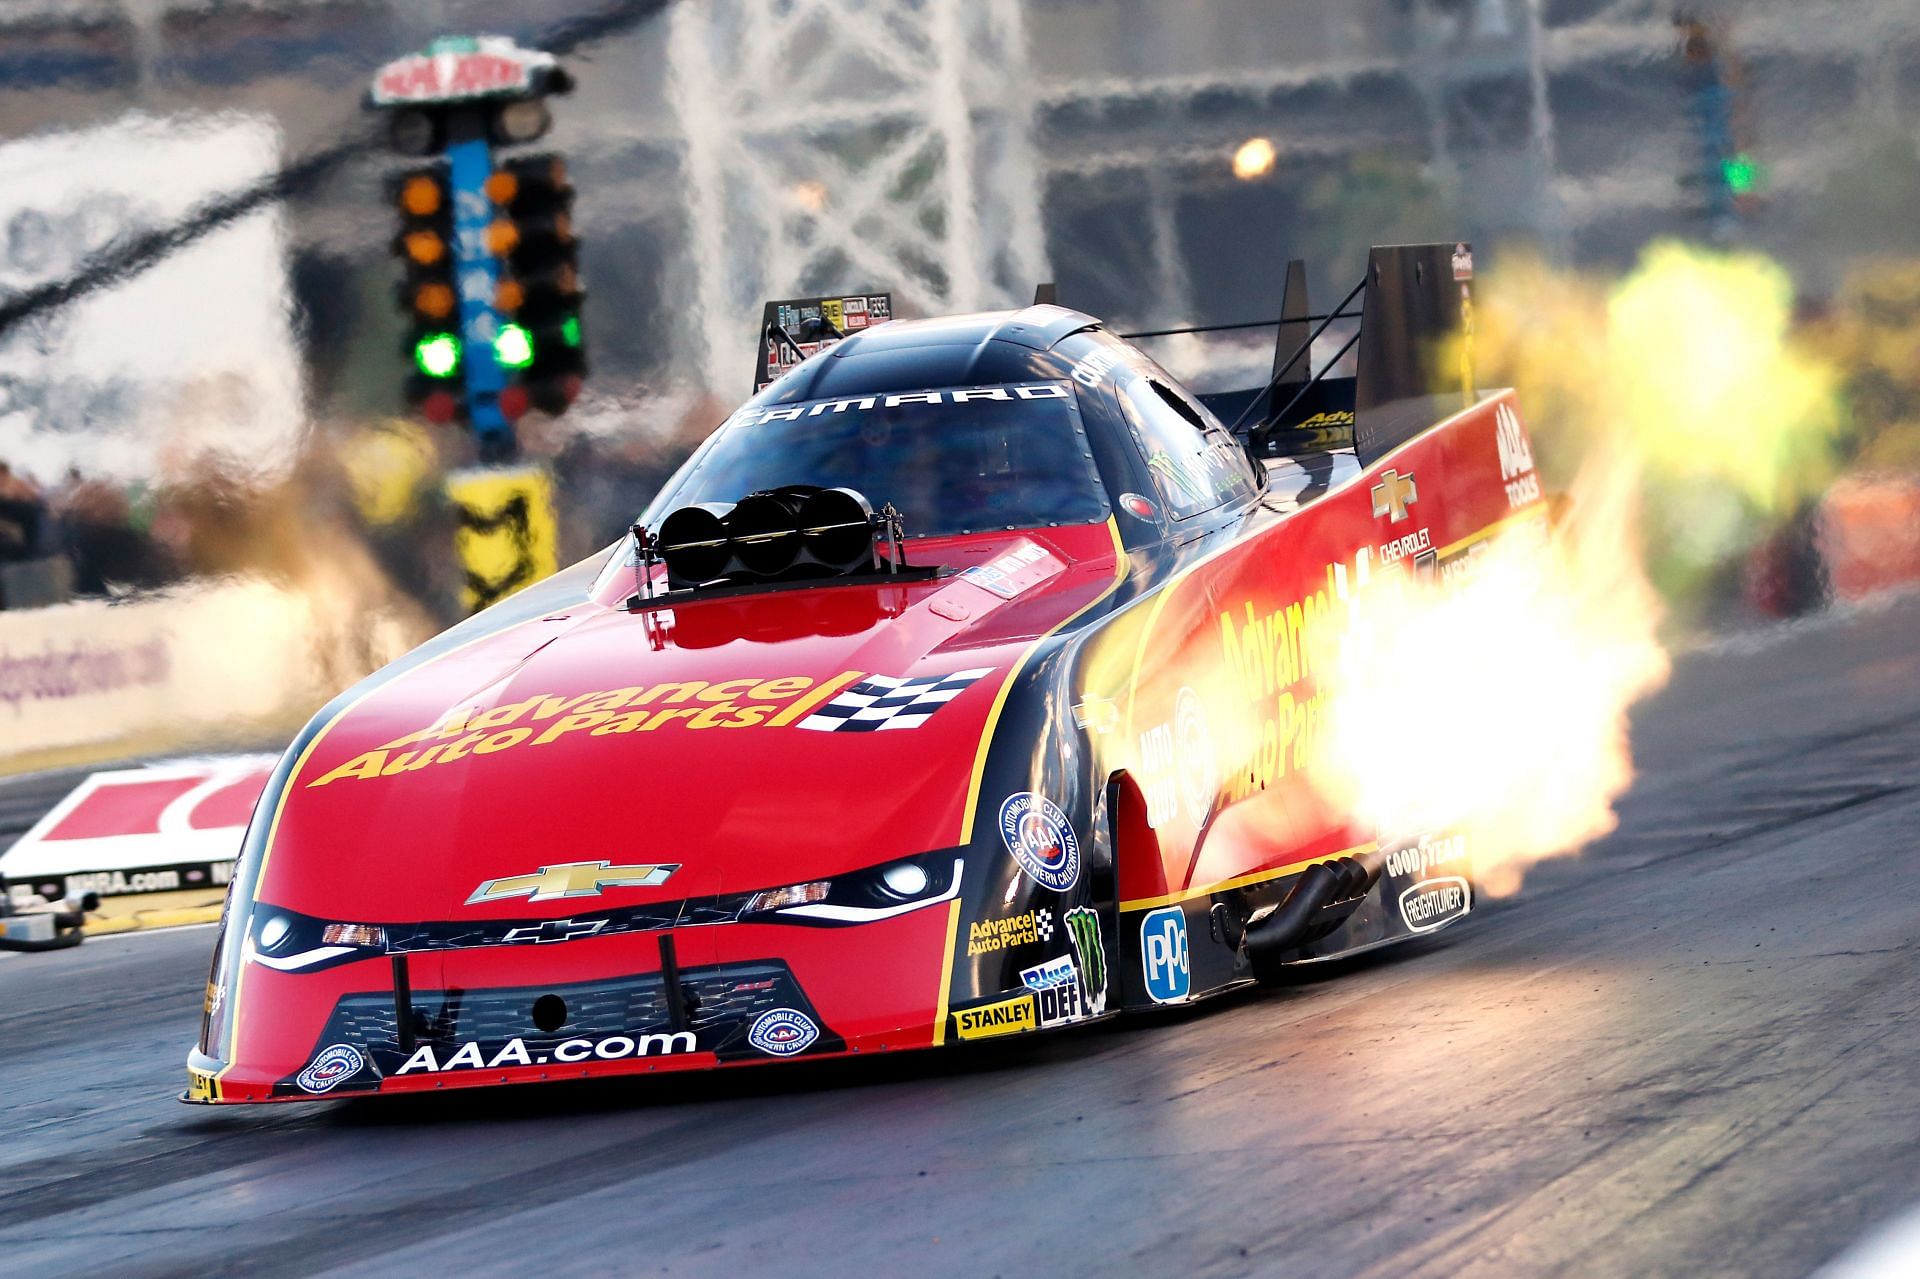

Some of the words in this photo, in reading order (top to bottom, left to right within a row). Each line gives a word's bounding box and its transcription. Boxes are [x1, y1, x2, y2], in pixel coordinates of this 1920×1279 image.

[734, 384, 1070, 428] CAMARO
[1504, 473, 1540, 509] TOOLS
[1379, 527, 1432, 566] CHEVROLET
[374, 674, 815, 751] Advance
[306, 726, 519, 789] Auto
[530, 700, 777, 746] Parts
[1043, 803, 1066, 829] CLUB
[1026, 826, 1060, 850] AAA
[1011, 840, 1058, 886] SOUTHERN
[1057, 833, 1077, 886] CALIFORNIA
[1385, 834, 1466, 878] GOODYEAR
[64, 869, 181, 894] NHRA.com
[1404, 886, 1462, 924] FREIGHTLINER
[967, 937, 1001, 957] Auto
[1000, 928, 1036, 950] Parts
[968, 912, 1033, 942] Advance
[1022, 963, 1074, 989] Blue
[961, 1001, 1032, 1032] STANLEY
[1039, 983, 1078, 1021] DEF
[753, 1012, 795, 1038] AUTOMOBILE
[769, 1029, 799, 1040] AAA
[313, 1048, 352, 1069] AUTOMOBILE
[396, 1030, 697, 1076] AAA.com
